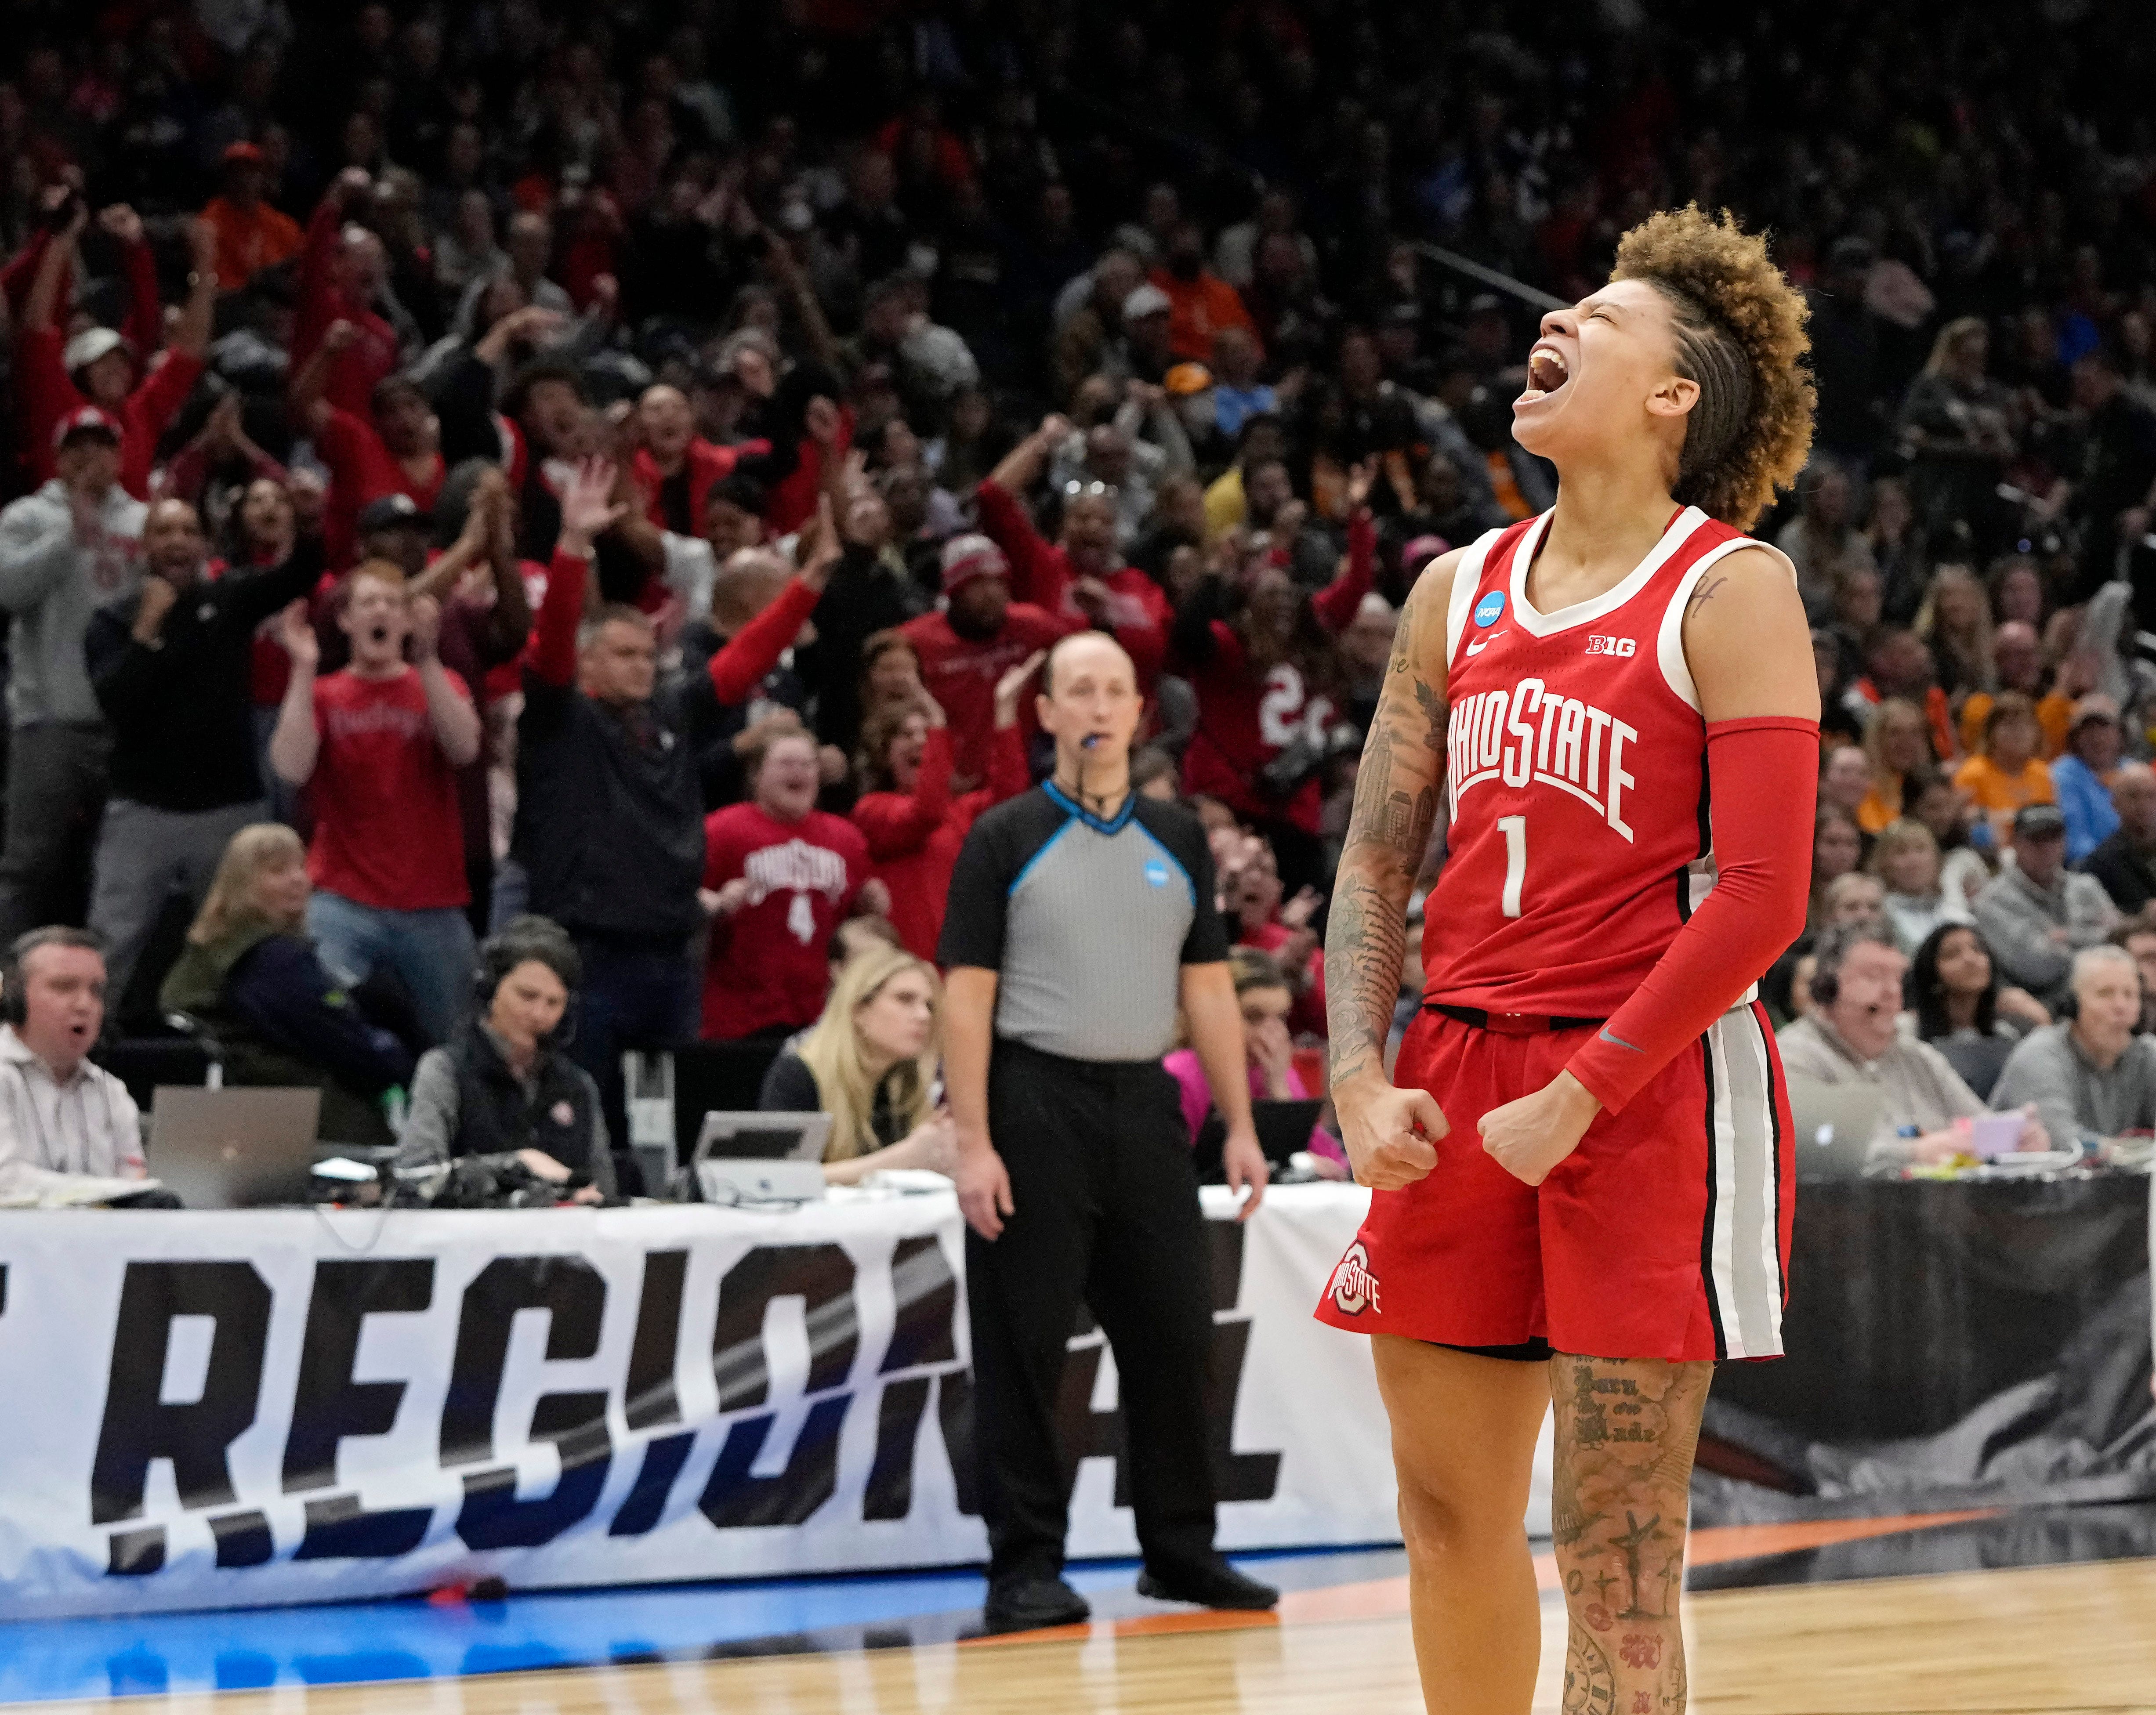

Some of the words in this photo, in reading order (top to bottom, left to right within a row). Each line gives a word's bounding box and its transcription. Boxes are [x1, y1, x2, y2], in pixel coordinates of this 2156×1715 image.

[1477, 607, 1501, 617] NCAA
[1447, 691, 1510, 826] OHIO
[1503, 678, 1638, 844] STATE
[1497, 815, 1527, 918] 1
[1345, 1260, 1381, 1314] STATE
